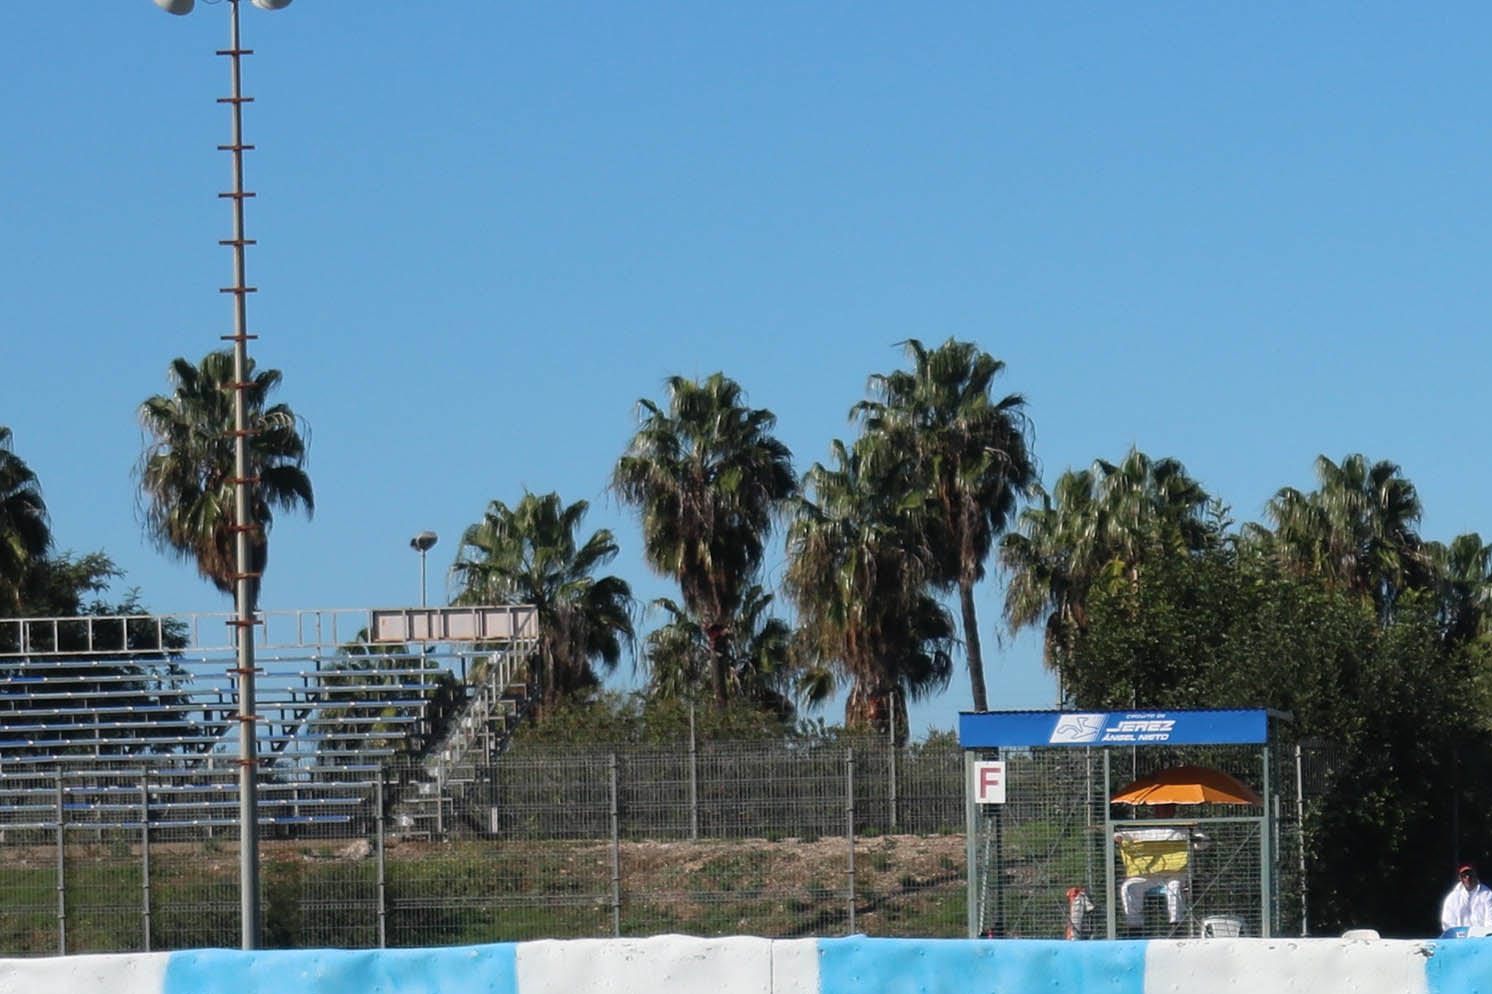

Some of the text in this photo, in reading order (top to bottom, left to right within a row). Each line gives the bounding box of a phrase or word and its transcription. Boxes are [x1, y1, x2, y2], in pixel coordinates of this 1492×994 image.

[1106, 720, 1176, 733] JEREZ
[1138, 733, 1169, 741] NIETO
[980, 767, 1001, 798] F
